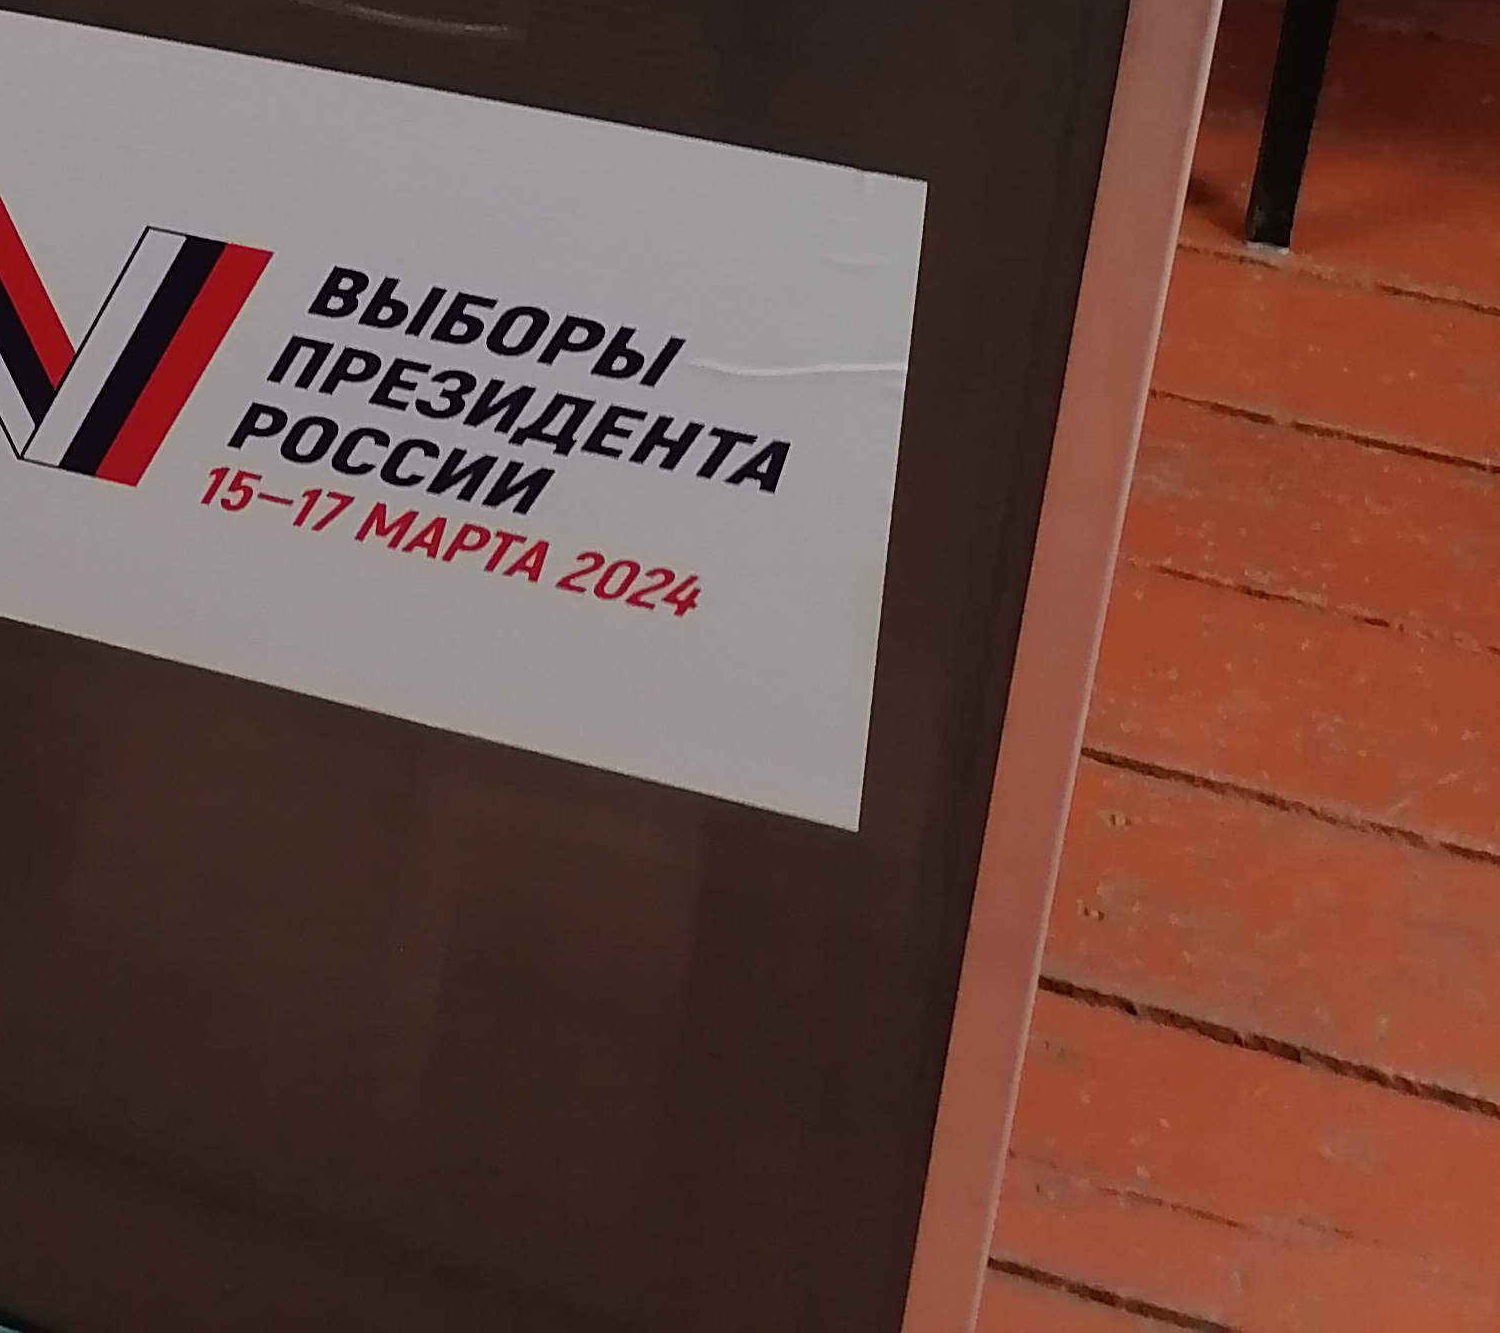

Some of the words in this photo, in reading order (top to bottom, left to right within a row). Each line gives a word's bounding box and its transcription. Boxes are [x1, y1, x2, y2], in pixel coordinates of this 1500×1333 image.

[308, 266, 686, 389] ВЫБОРЫ
[226, 401, 556, 515] РОССИИ
[266, 334, 791, 494] ПРЕЗИДЕНТА
[355, 502, 551, 584] МАРТА
[556, 551, 702, 617] 2024
